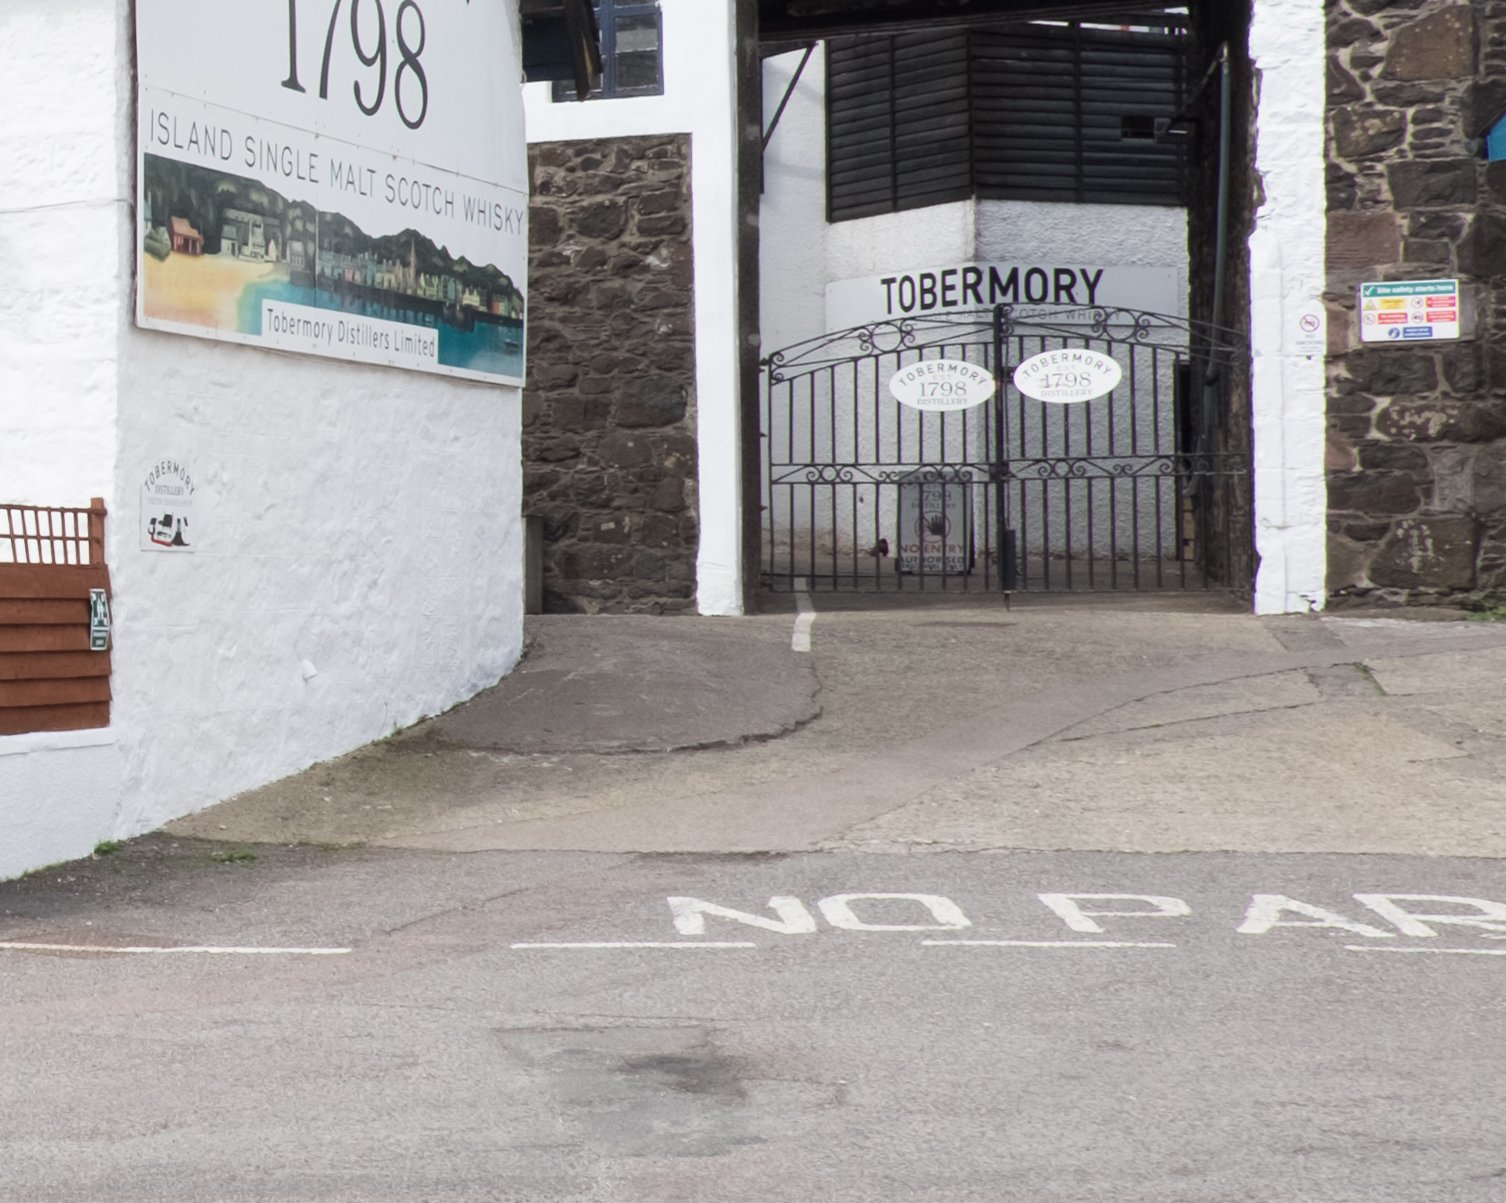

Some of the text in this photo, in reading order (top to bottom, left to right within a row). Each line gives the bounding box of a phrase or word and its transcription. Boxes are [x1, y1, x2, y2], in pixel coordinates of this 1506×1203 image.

[149, 108, 525, 236] ISLAND SINGLE MALT SCOTCH WHISKY
[880, 265, 1105, 315] TOBERMORY
[267, 307, 436, 359] Tobermory Distillers Limited
[898, 362, 988, 387] TOBERMORY
[1022, 352, 1113, 379] TOBERMORY
[1043, 372, 1092, 389] 1798
[919, 381, 968, 397] 1798
[144, 460, 195, 496] TOBERMORY
[667, 894, 972, 935] NO
